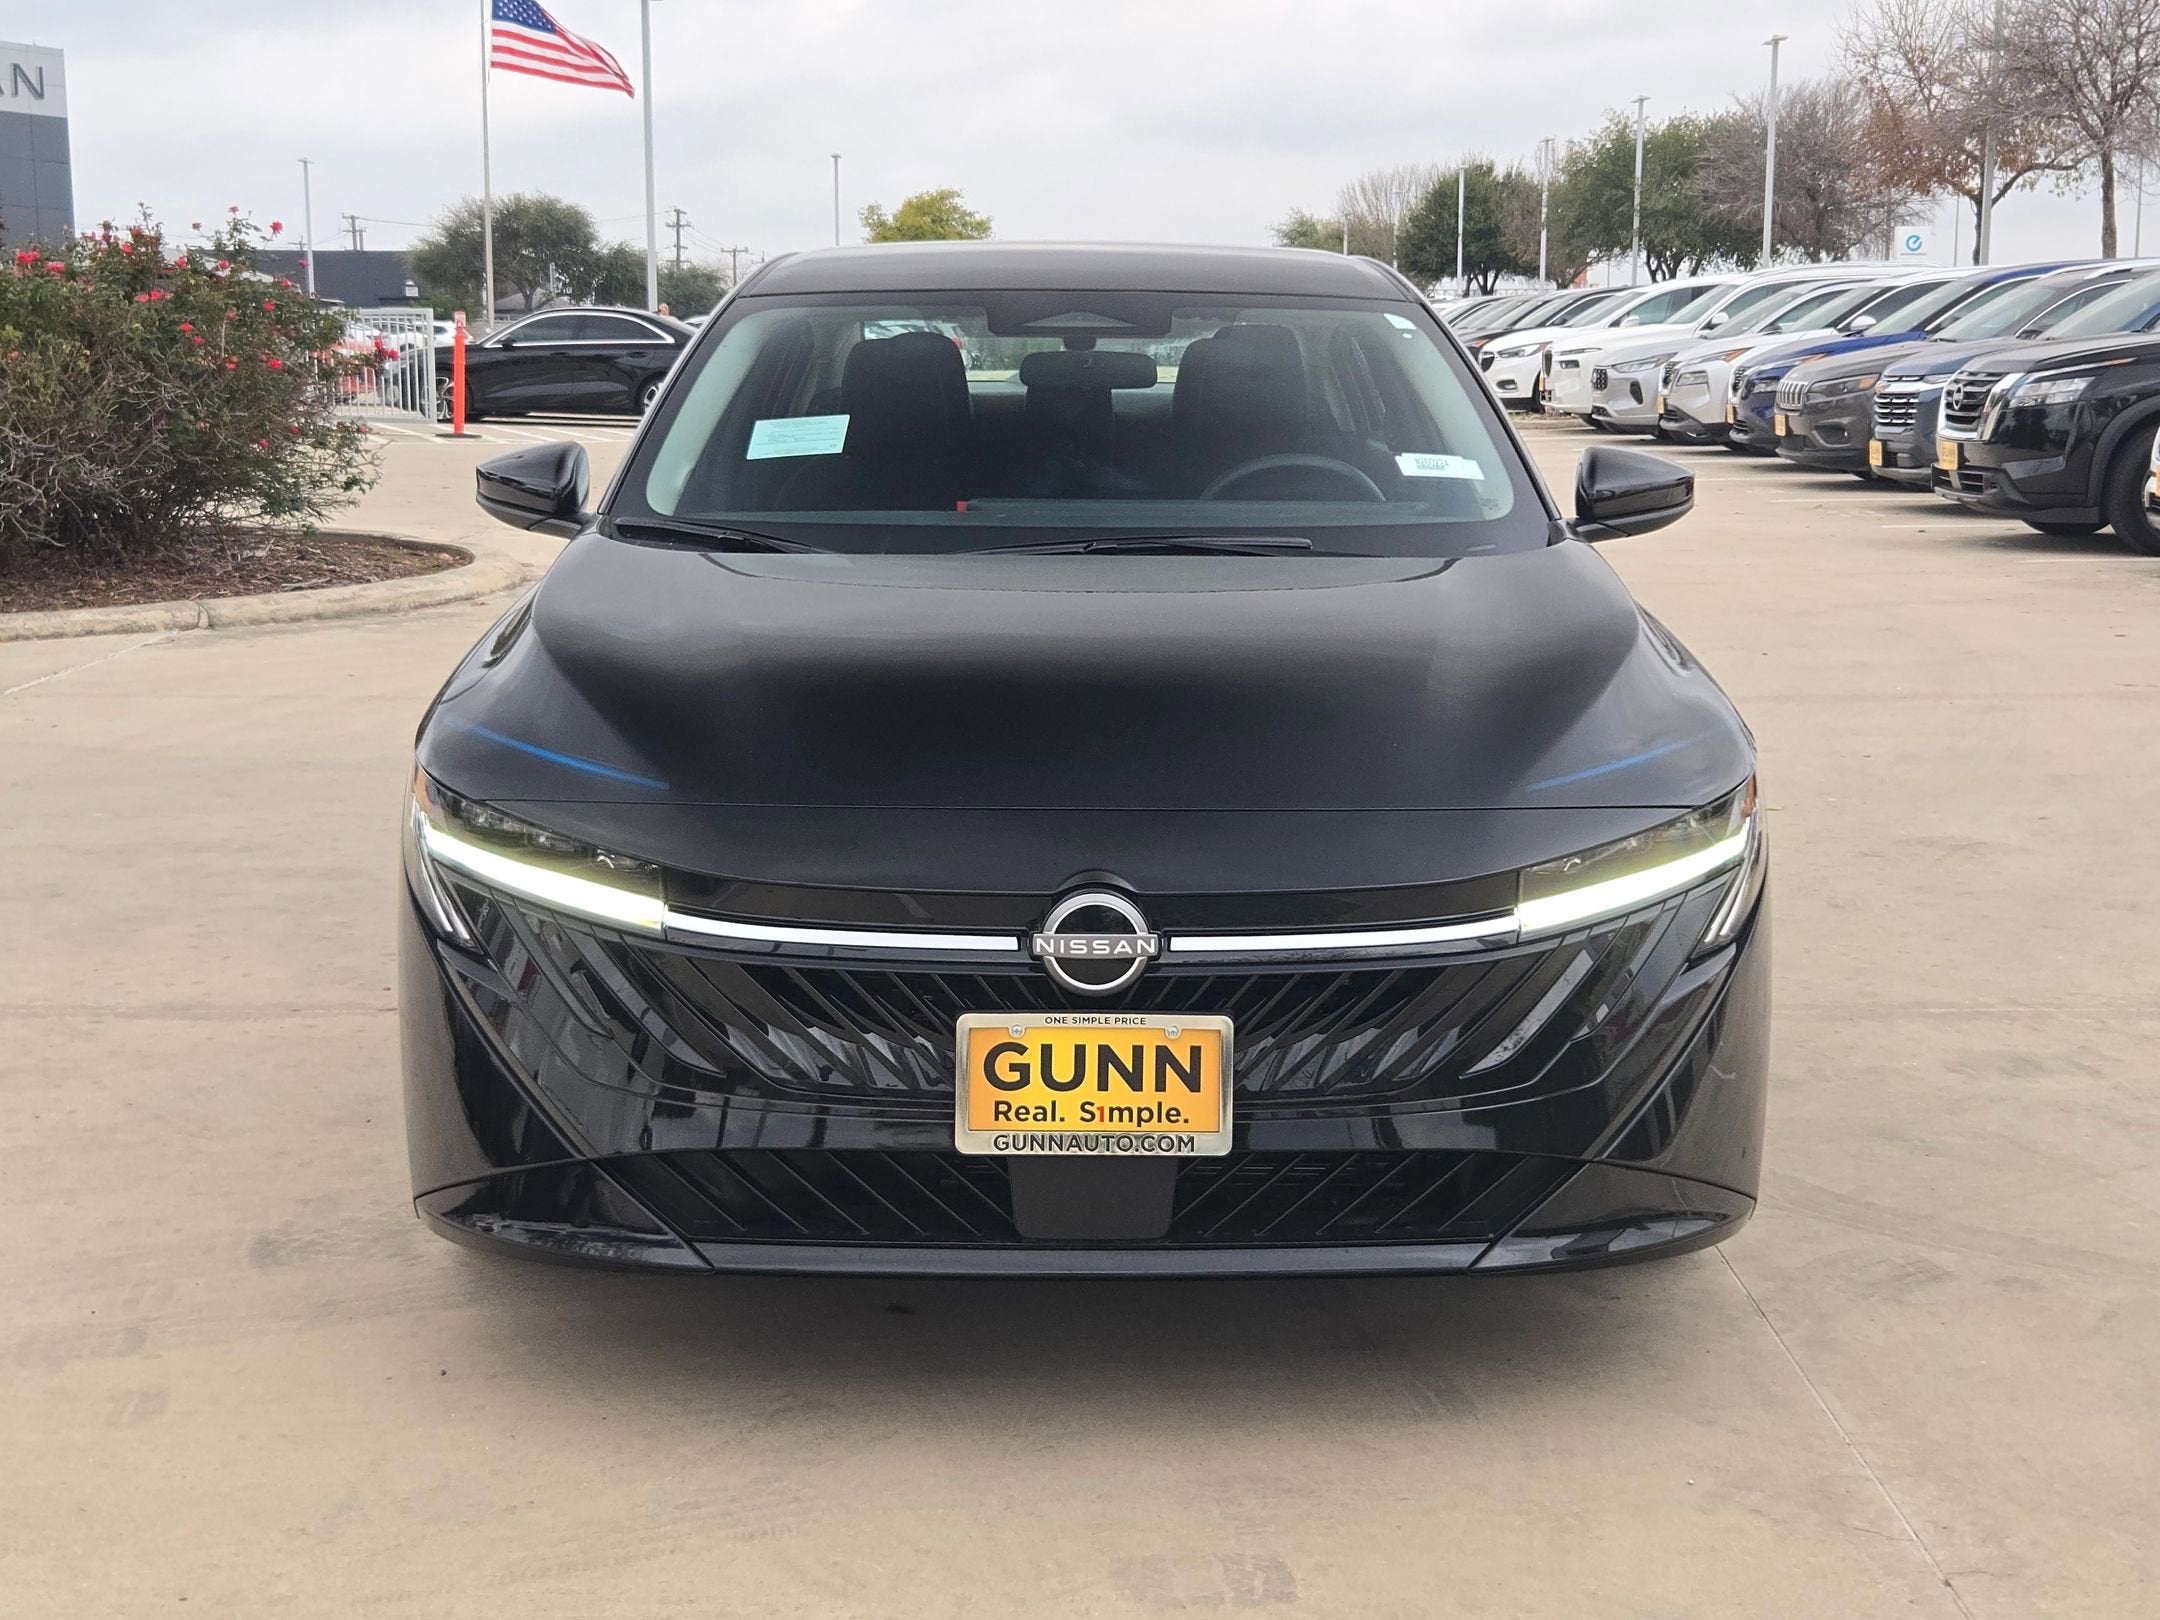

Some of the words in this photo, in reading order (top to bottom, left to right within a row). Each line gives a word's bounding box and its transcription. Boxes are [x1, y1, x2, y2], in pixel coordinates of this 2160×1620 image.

[0, 63, 45, 100] N
[1036, 938, 1155, 955] NISSAN
[1044, 1016, 1069, 1025] ONE
[1072, 1016, 1111, 1025] SIMPLE
[1114, 1017, 1147, 1025] PRICE
[983, 1041, 1202, 1093] GUNN
[993, 1100, 1065, 1122] Real.
[1079, 1101, 1190, 1127] S1mple.
[993, 1134, 1196, 1153] GUNNAUTO.COM
